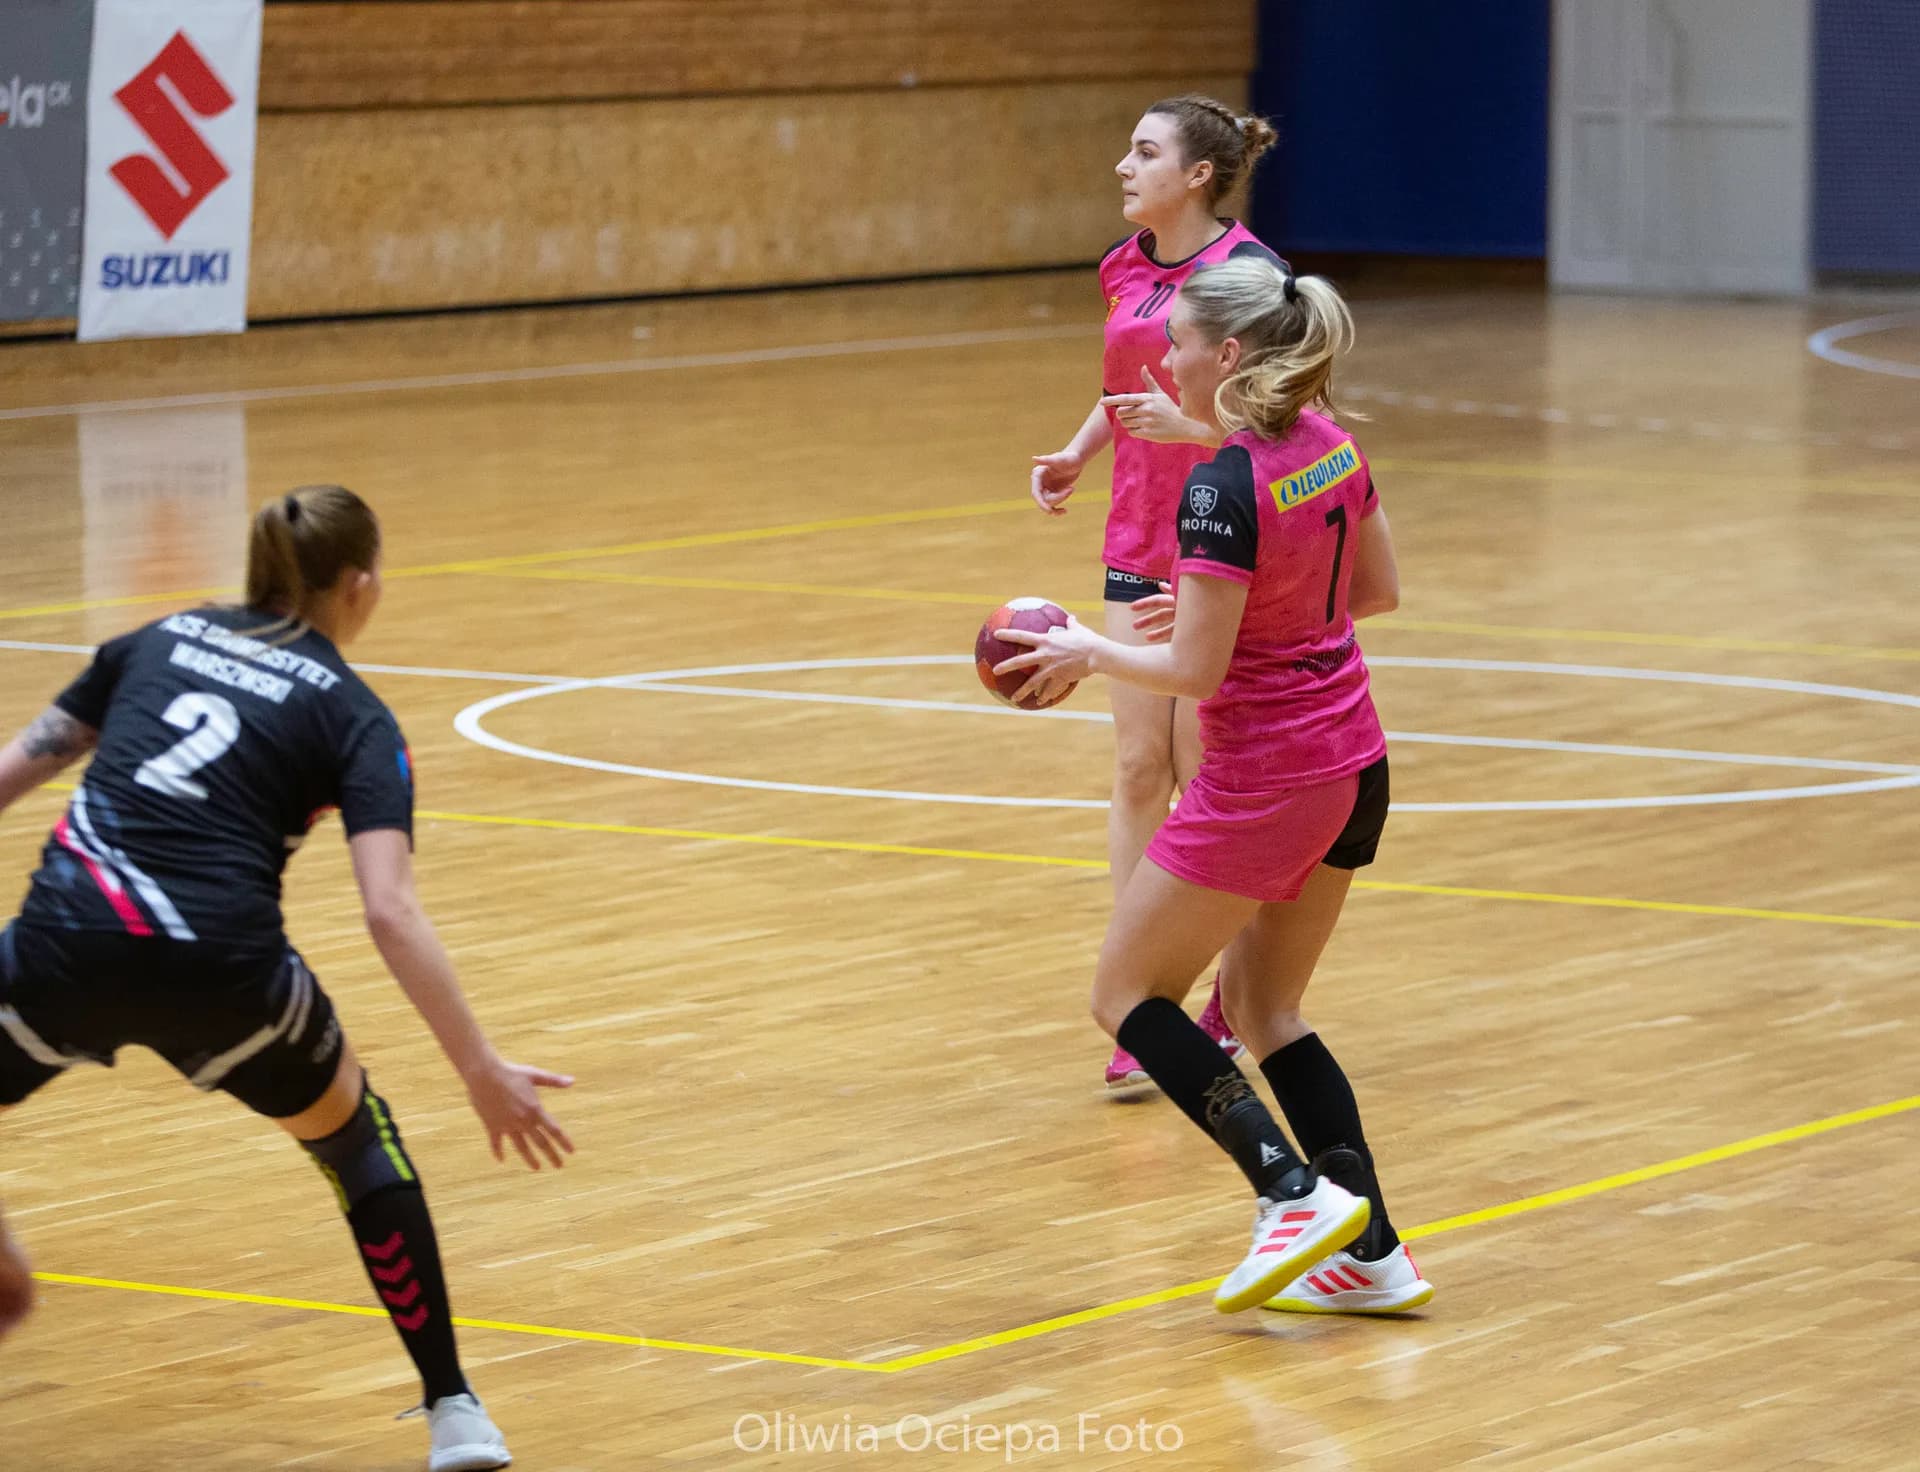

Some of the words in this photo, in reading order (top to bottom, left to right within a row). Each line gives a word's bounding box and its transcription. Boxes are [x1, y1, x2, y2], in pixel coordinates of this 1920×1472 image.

[101, 251, 230, 290] SUZUKI
[1134, 281, 1176, 319] 10
[1300, 447, 1356, 497] LEWIATAN
[1181, 518, 1233, 537] PROFIKA
[1325, 505, 1347, 625] 7
[134, 691, 242, 801] 2
